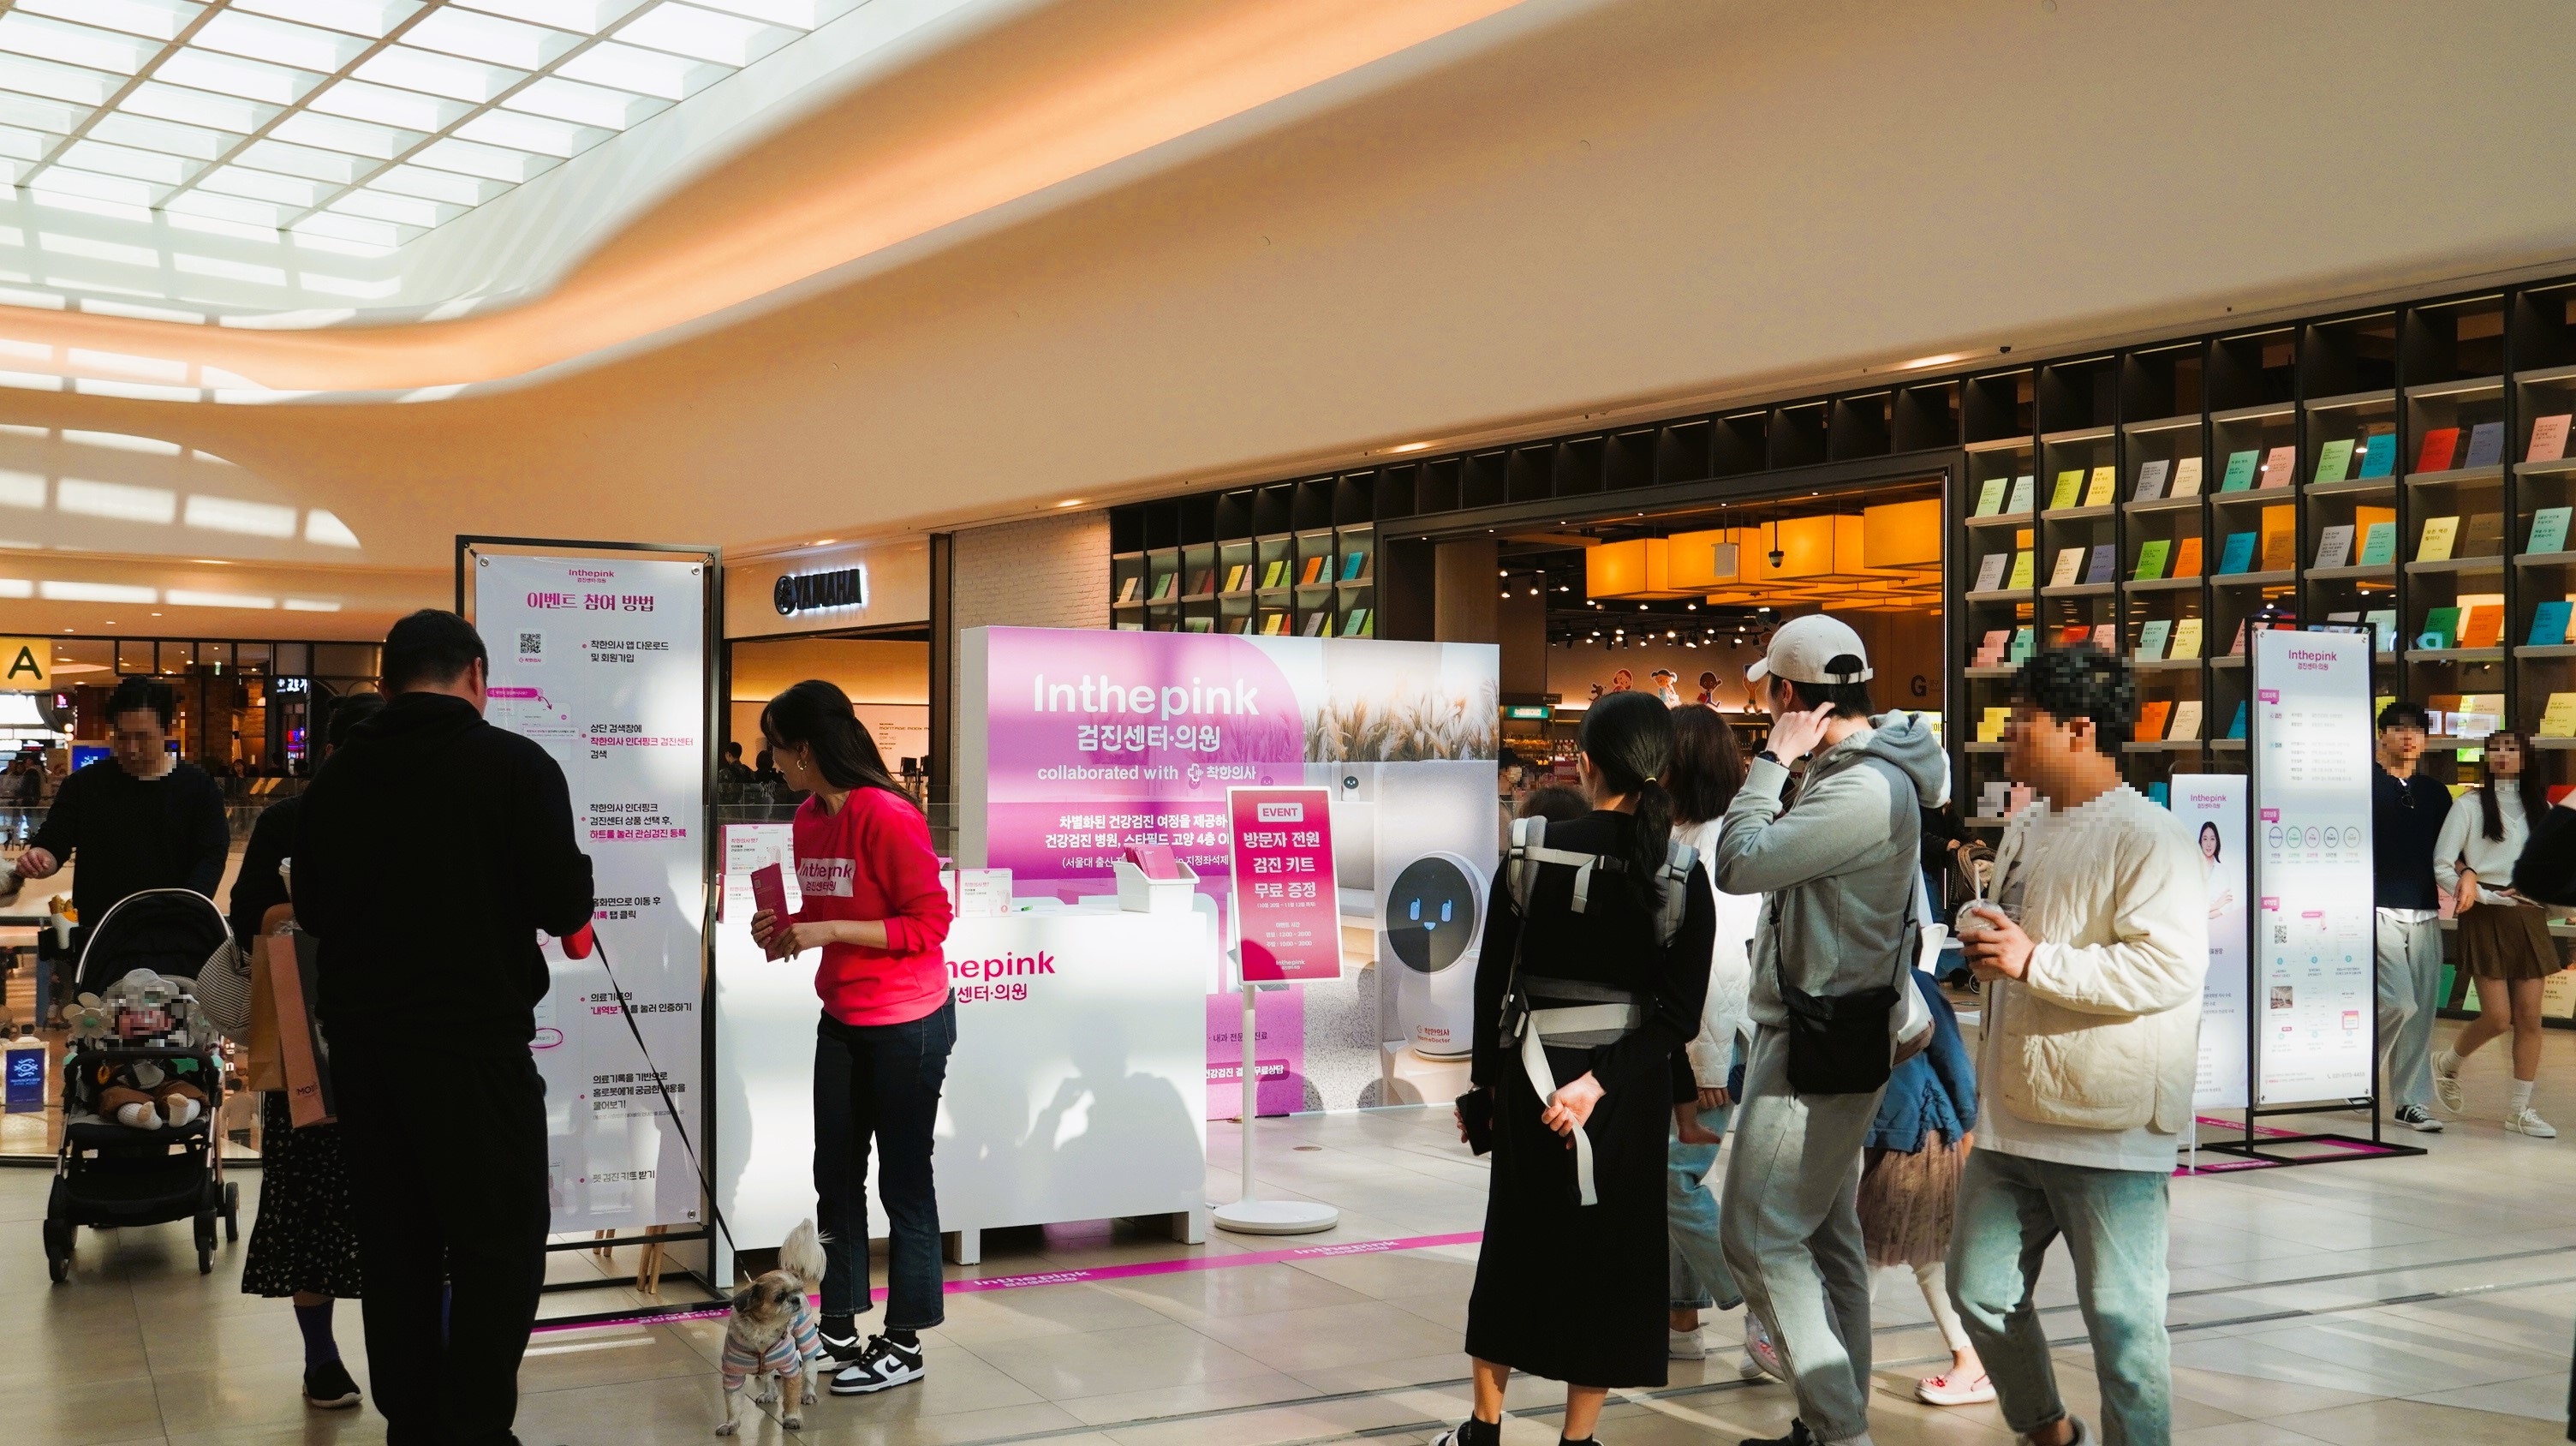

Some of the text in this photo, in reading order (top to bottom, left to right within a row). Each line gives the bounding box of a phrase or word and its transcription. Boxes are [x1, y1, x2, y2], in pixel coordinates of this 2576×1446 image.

[569, 569, 615, 578] Inthepink
[794, 569, 862, 610] YAMAHA
[527, 592, 654, 612] 이벤트 참여 방법
[591, 640, 669, 651] 착한의사 앱 다운로드
[591, 654, 635, 663] 및 회원가입
[2288, 649, 2337, 662] Inthepink
[7, 645, 43, 680] A
[1911, 675, 1927, 696] G
[1034, 673, 1260, 720] Inthepink
[591, 724, 642, 734] 상단 검색창에
[591, 737, 694, 747] 착한의사 인더핑크 검진센터
[1077, 724, 1220, 753] 검진센터·의원
[591, 750, 607, 759] 검색
[1037, 764, 1178, 780] collaborated with
[1206, 765, 1256, 780] 착한의사
[2190, 793, 2227, 803] Inthepink
[590, 804, 659, 813] 착한의사 인더핑크
[1262, 808, 1298, 817] EVENT
[590, 816, 624, 827] 검진센터
[625, 816, 642, 826] 상품
[643, 816, 660, 826] 선택
[1059, 814, 1106, 829] 차별화된
[1108, 814, 1154, 829] 건강검진
[1157, 814, 1190, 828] 여정을
[589, 828, 687, 840] 하트를 눌러 관심검진 등록
[1243, 831, 1321, 849] 방문자 전원
[1045, 834, 1092, 848] 건강검진
[1094, 834, 1121, 849] 병원,
[1124, 833, 1170, 846] 스타필드
[1172, 833, 1195, 846] 고양
[1196, 833, 1215, 846] 4층
[1062, 857, 1093, 869] (서울대
[1186, 854, 1229, 866] 지정좌석제
[1253, 857, 1315, 874] 검진 키트
[1254, 881, 1317, 899] 무료 증정
[635, 897, 651, 906] 이동
[653, 896, 661, 905] 후
[593, 910, 636, 920] 기록 탭 클릭
[590, 992, 633, 1002] 의료기의
[641, 1004, 657, 1013] 눌러
[659, 1002, 692, 1013] 인증하기
[1213, 1033, 1228, 1043] 내과
[1417, 1035, 1451, 1043] HomeDoctor
[1255, 1064, 1285, 1076] 무료상담
[593, 1072, 668, 1084] 의료기록을 기반으로
[593, 1086, 634, 1098] 홈로봇에게
[635, 1084, 660, 1096] 궁금한
[593, 1100, 626, 1111] 물어보기
[603, 1173, 619, 1183] 검진
[621, 1172, 637, 1180] 키트
[638, 1170, 655, 1180] 받기
